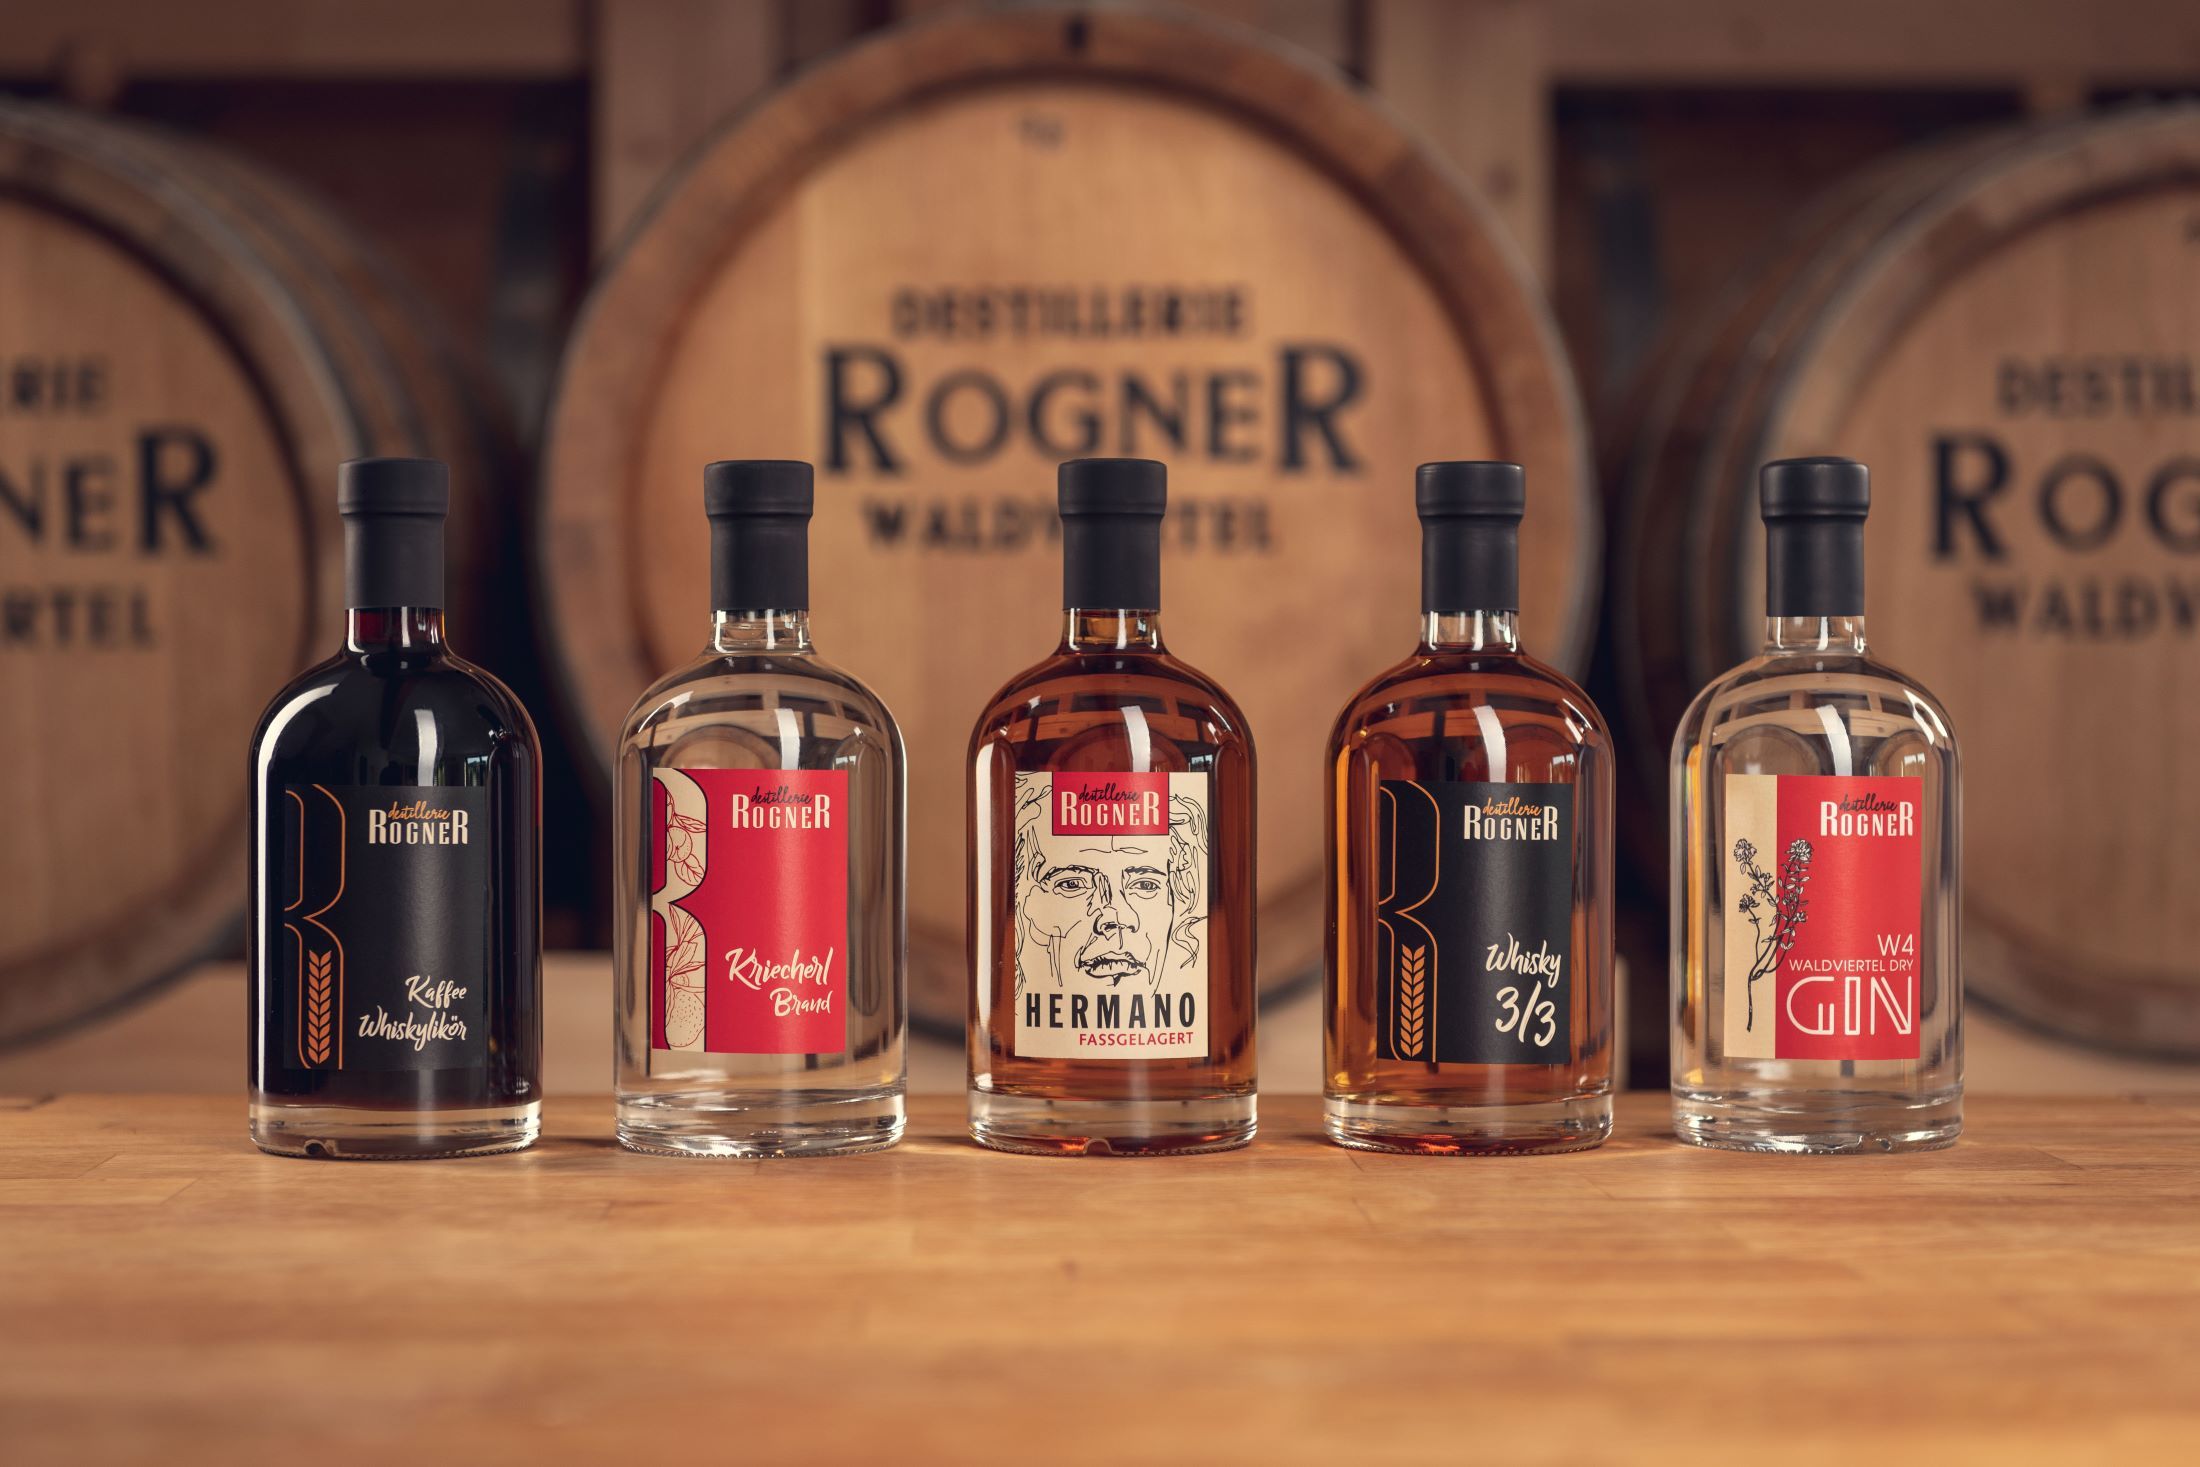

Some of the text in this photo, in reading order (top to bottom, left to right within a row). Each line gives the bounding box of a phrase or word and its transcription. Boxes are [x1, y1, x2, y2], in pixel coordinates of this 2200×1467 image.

[890, 286, 1247, 341] DESTILLERIE
[822, 344, 1366, 475] ROGNER
[1930, 432, 2200, 563] ROG
[387, 801, 450, 820] destillerie
[751, 786, 812, 806] destillerie
[1061, 791, 1160, 826] ROGNER
[1079, 783, 1139, 802] destillerie
[1482, 797, 1542, 816] destillerie
[1839, 793, 1898, 812] destillerie
[368, 809, 468, 845] ROGNER
[732, 793, 831, 829] ROGNER
[1463, 805, 1558, 841] ROGNER
[1820, 801, 1913, 837] ROGNER
[1485, 932, 1562, 988] Whisky
[1877, 934, 1914, 956] W4
[725, 946, 834, 990] Kriecherl
[1789, 958, 1914, 972] WALDVIERTEL DRY
[405, 975, 467, 1009] Kaffee
[769, 987, 833, 1017] Brand
[1786, 976, 1912, 1036] GIN
[358, 1005, 467, 1052] Whiskylikör
[1026, 992, 1196, 1029] HERMANO
[1495, 980, 1556, 1047] 3/3
[1079, 1031, 1194, 1046] FASSGELAGERT
